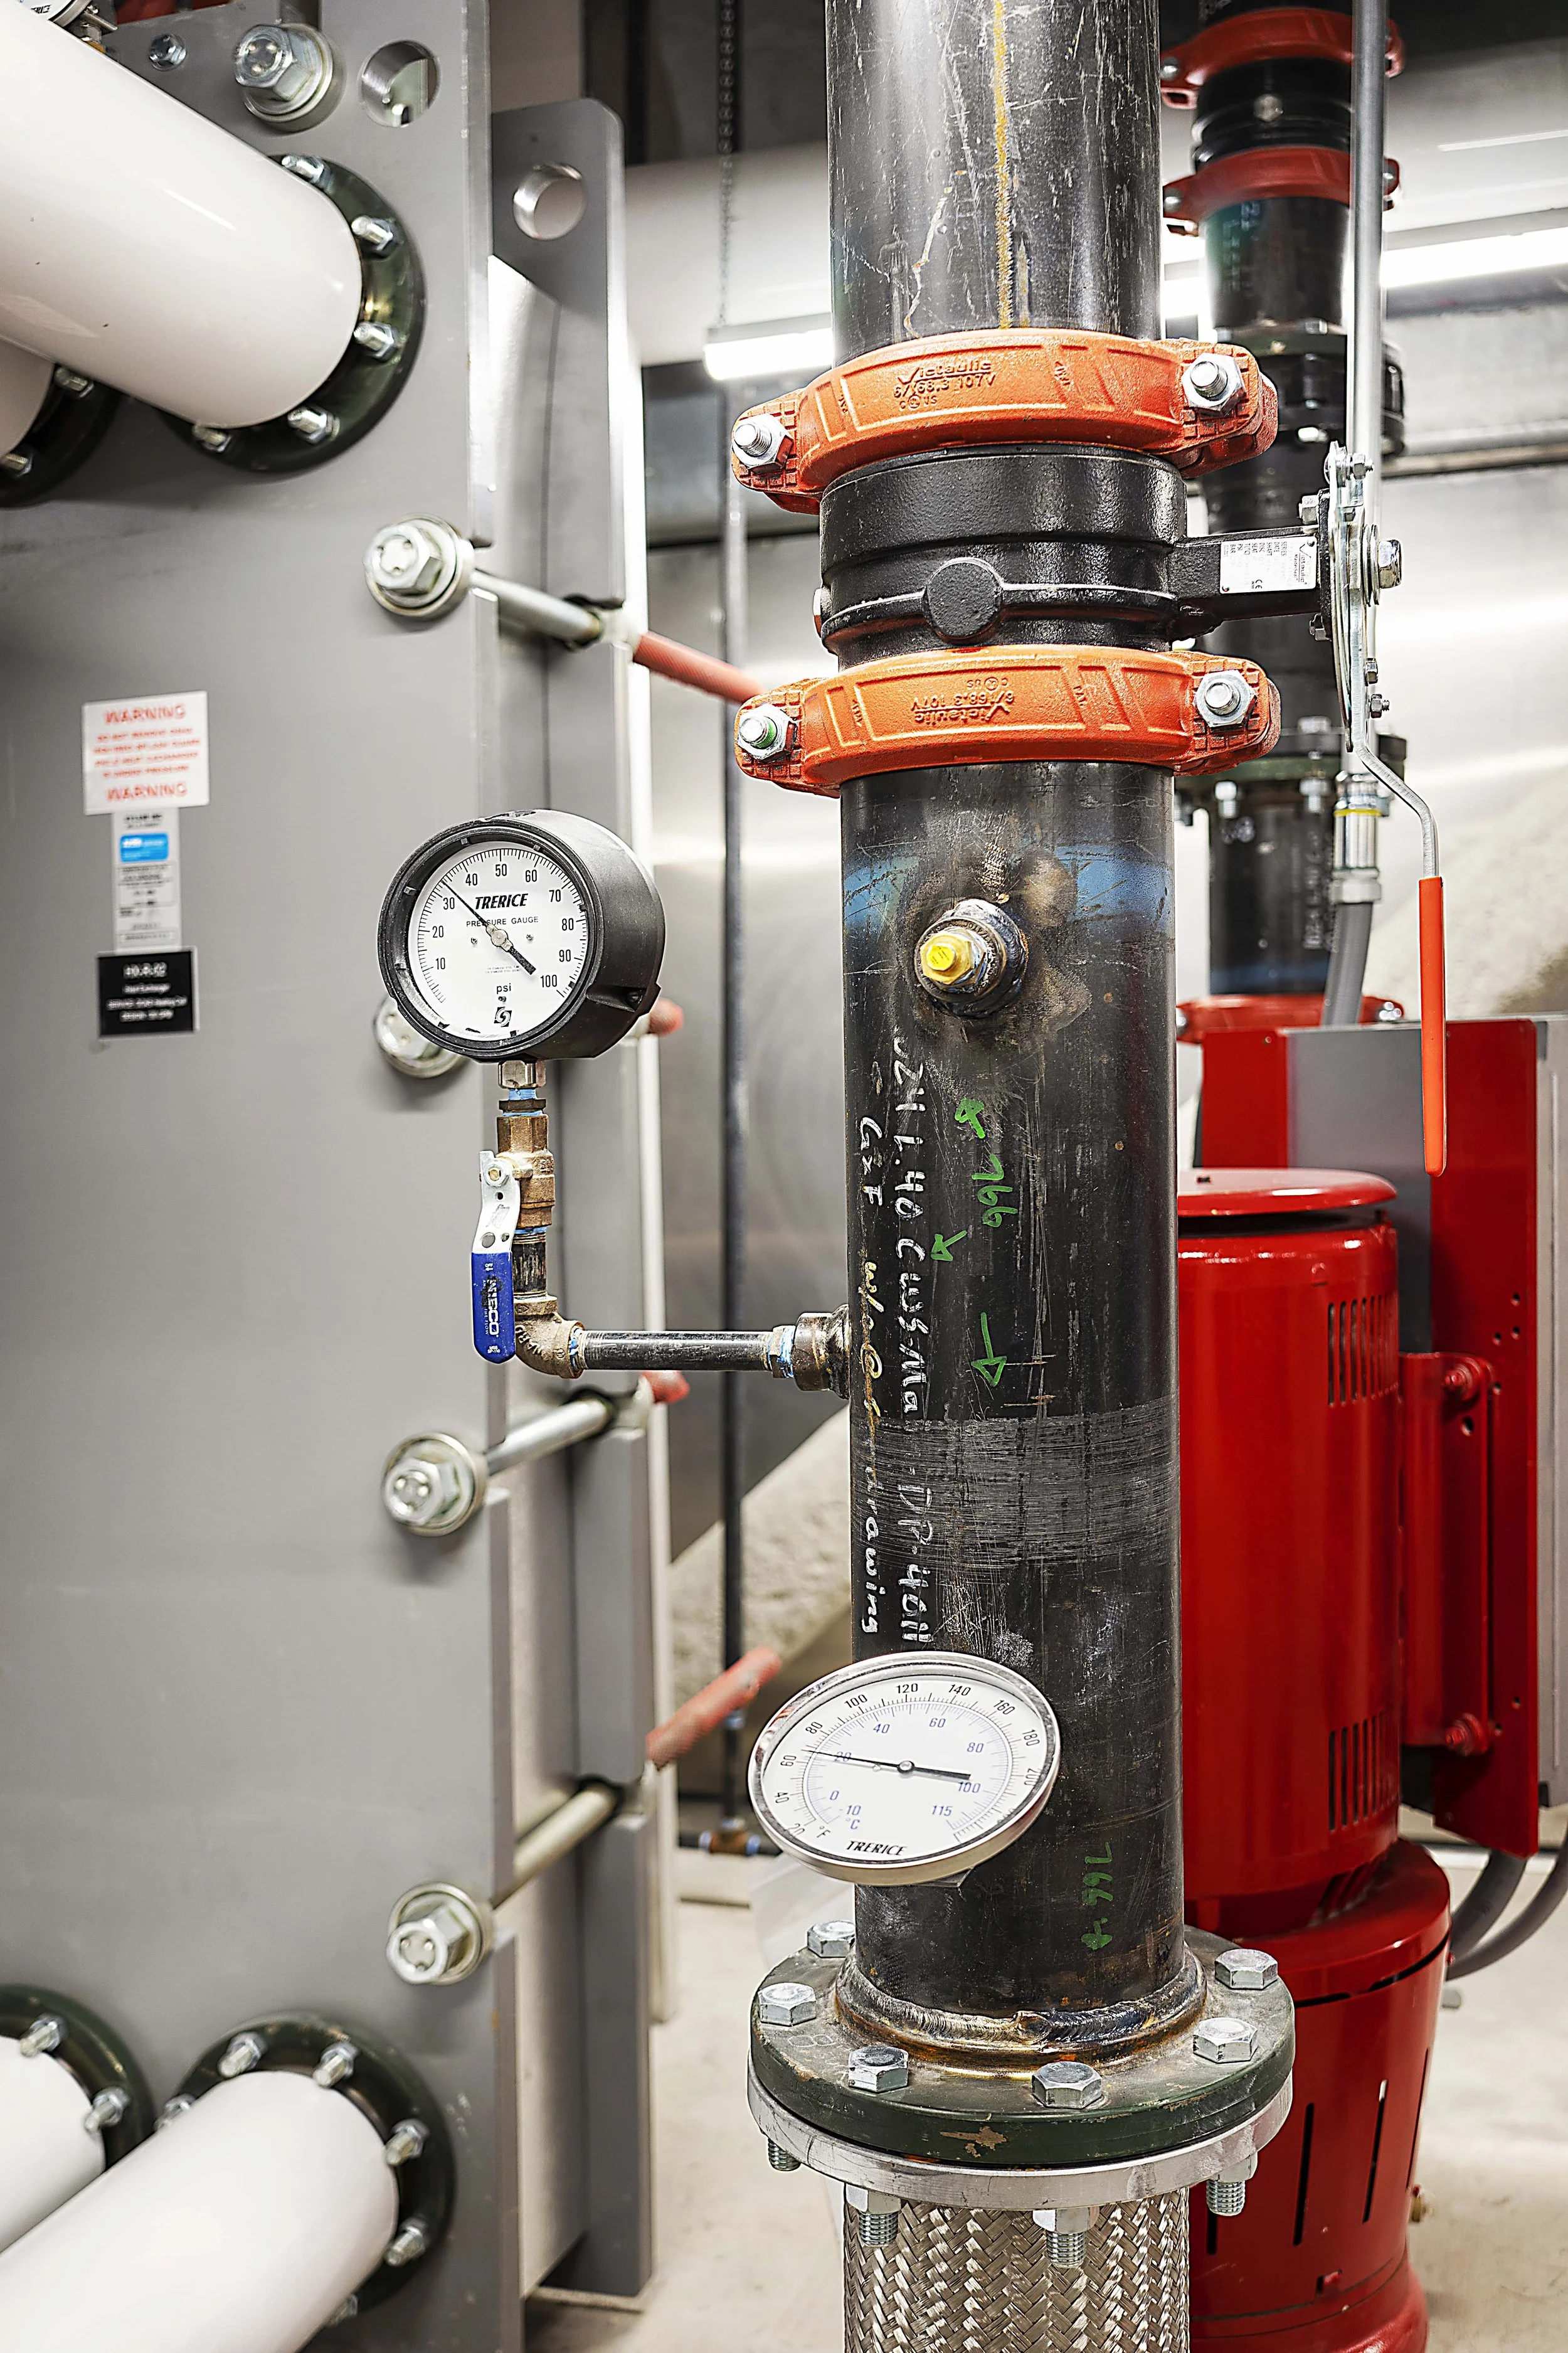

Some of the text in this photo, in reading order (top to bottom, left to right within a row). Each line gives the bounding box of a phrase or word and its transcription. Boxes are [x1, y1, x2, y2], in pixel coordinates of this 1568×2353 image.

[897, 358, 992, 386] Victaulic
[1298, 543, 1311, 583] Victaulic
[105, 703, 186, 724] WARNING
[915, 702, 1010, 726] Victaulic
[107, 782, 188, 802] WARNING
[495, 864, 507, 876] 50
[525, 869, 538, 882] 60
[465, 873, 478, 886] 40
[475, 893, 528, 910] TRERICE
[549, 890, 561, 903] 70
[443, 898, 455, 910] 30
[466, 918, 507, 927] PRESURE
[561, 918, 574, 931] 80
[432, 926, 444, 938] 20
[559, 949, 571, 962] 90
[435, 958, 446, 970] 10
[540, 974, 558, 988] 100
[496, 983, 512, 994] psi
[971, 1153, 1019, 1228] 766
[896, 1683, 918, 1694] 120
[948, 1684, 972, 1697] 140
[844, 1694, 868, 1709] 100
[994, 1699, 1016, 1716] 160
[805, 1721, 823, 1734] 80
[872, 1723, 890, 1734] 40
[929, 1718, 946, 1728] 60
[1022, 1729, 1040, 1747] 180
[967, 1742, 983, 1753] 80
[780, 1755, 797, 1766] 60
[835, 1751, 852, 1762] 20
[1024, 1768, 1041, 1786] 200
[958, 1782, 980, 1793] 100
[775, 1791, 790, 1803] 40
[829, 1790, 839, 1800] 0
[931, 1805, 952, 1816] 115
[845, 1840, 908, 1856] TRERICE
